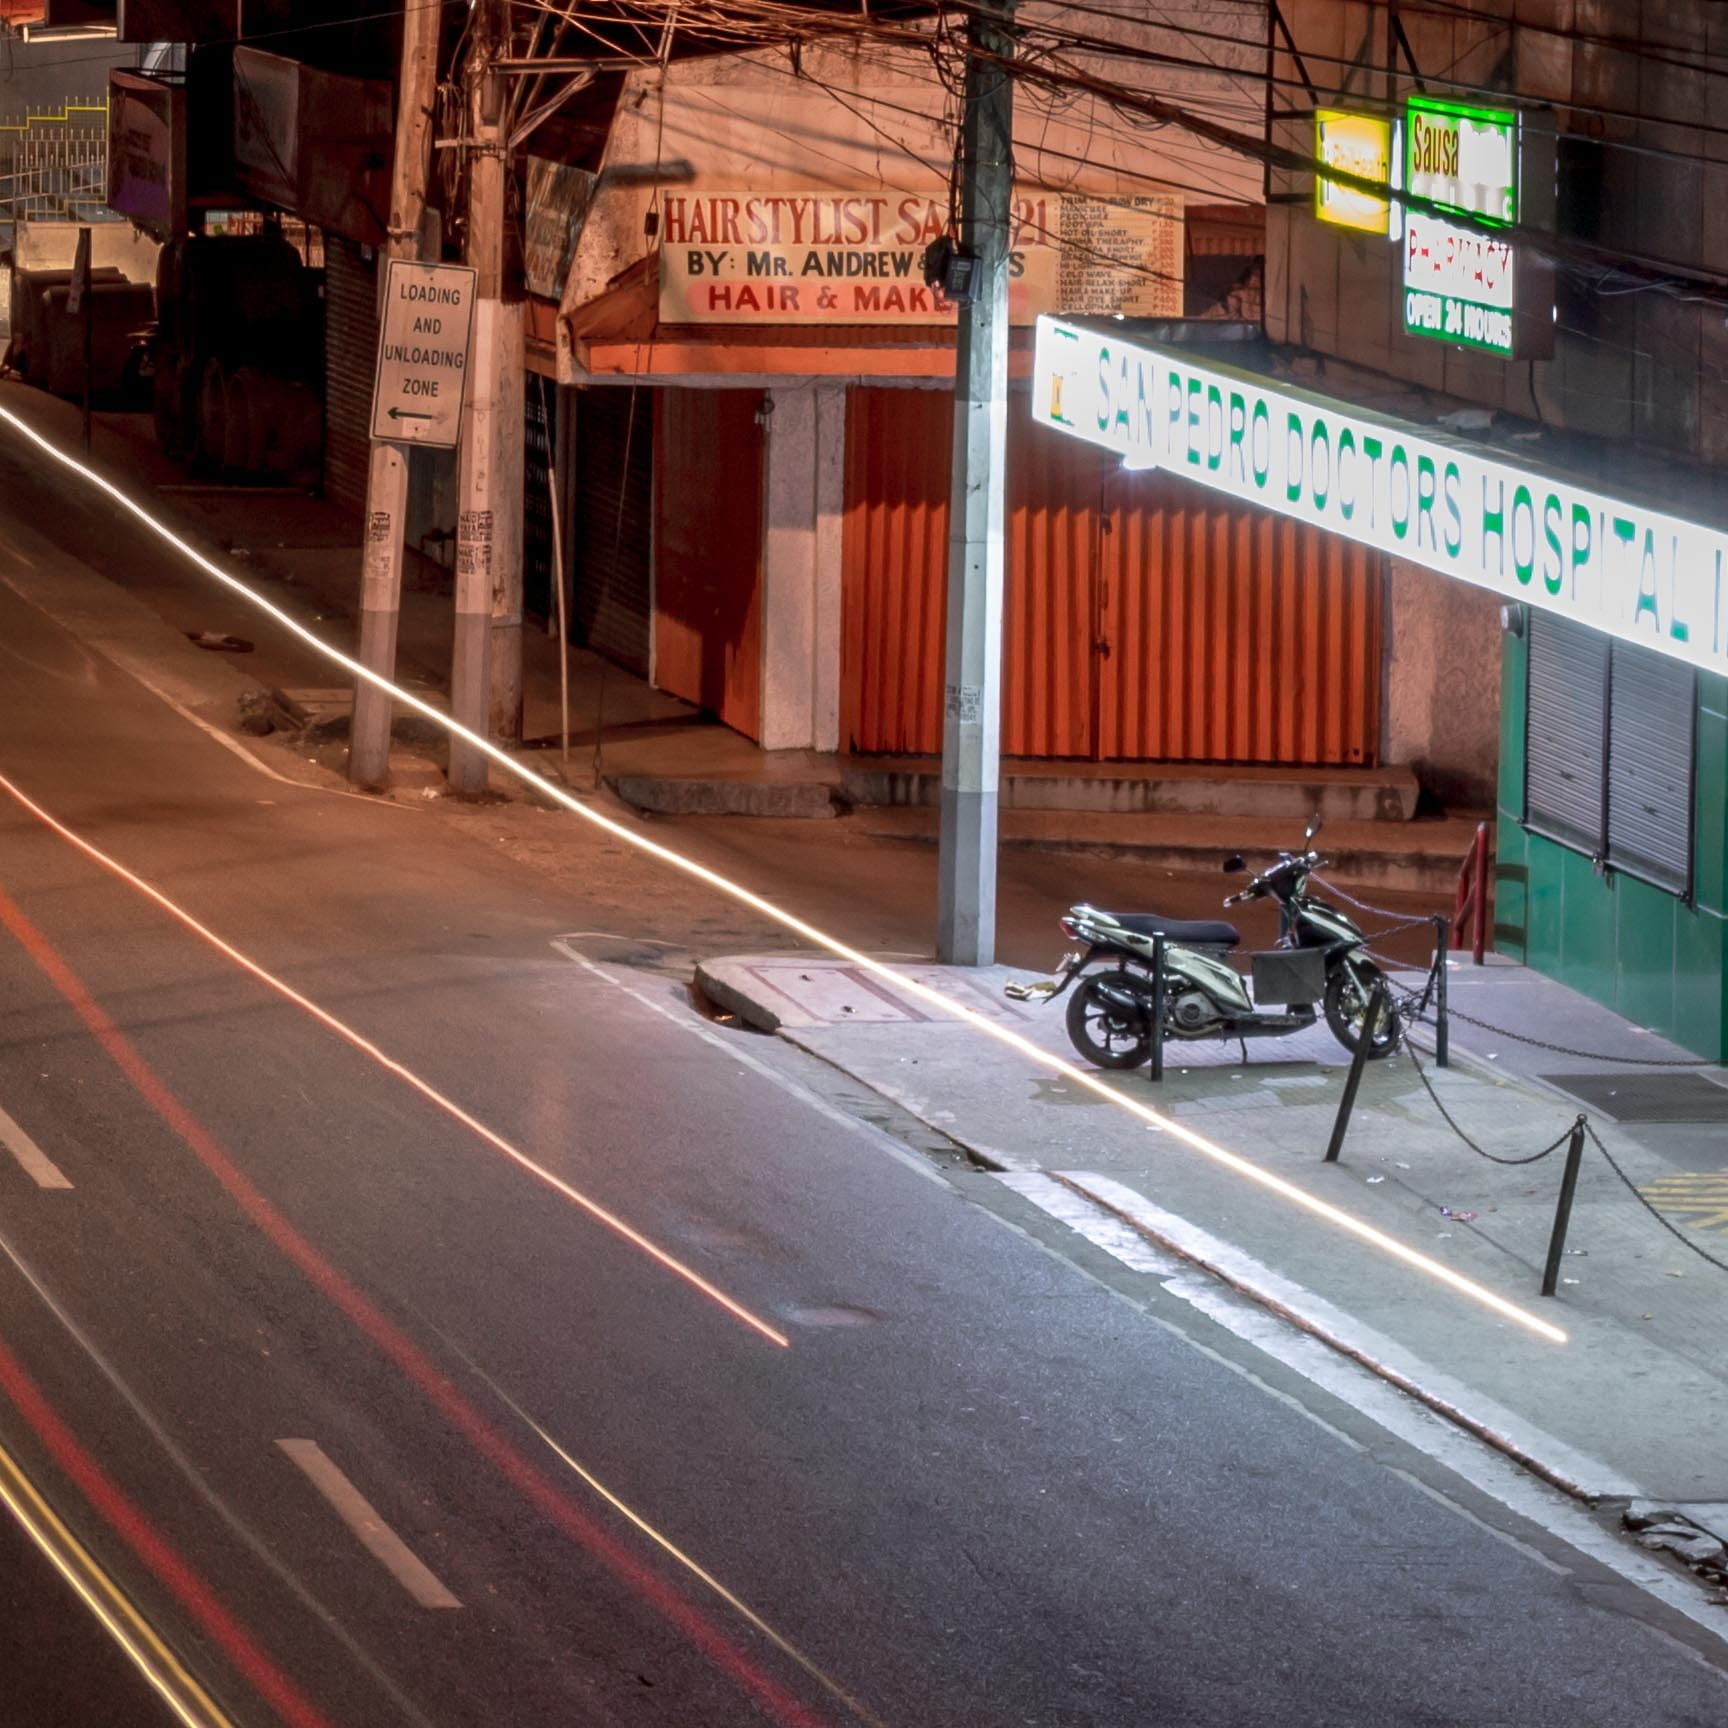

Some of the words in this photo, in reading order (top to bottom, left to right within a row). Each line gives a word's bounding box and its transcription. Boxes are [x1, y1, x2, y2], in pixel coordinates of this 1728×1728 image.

[1135, 196, 1153, 206] DRY
[801, 251, 914, 278] ANDREW
[400, 284, 461, 306] LOADING
[708, 285, 801, 312] HAIR
[817, 286, 838, 310] &
[413, 317, 442, 335] AND
[1407, 292, 1442, 330] OPEN
[1445, 299, 1462, 335] 24
[1464, 304, 1512, 349] HOURS
[385, 344, 464, 369] UNLOADING
[402, 378, 439, 397] ZONE
[1096, 347, 1153, 449] SAN
[1168, 371, 1271, 489] PEDRO
[1286, 412, 1463, 559] DOCTORS
[1480, 474, 1689, 644] HOSPITAL
